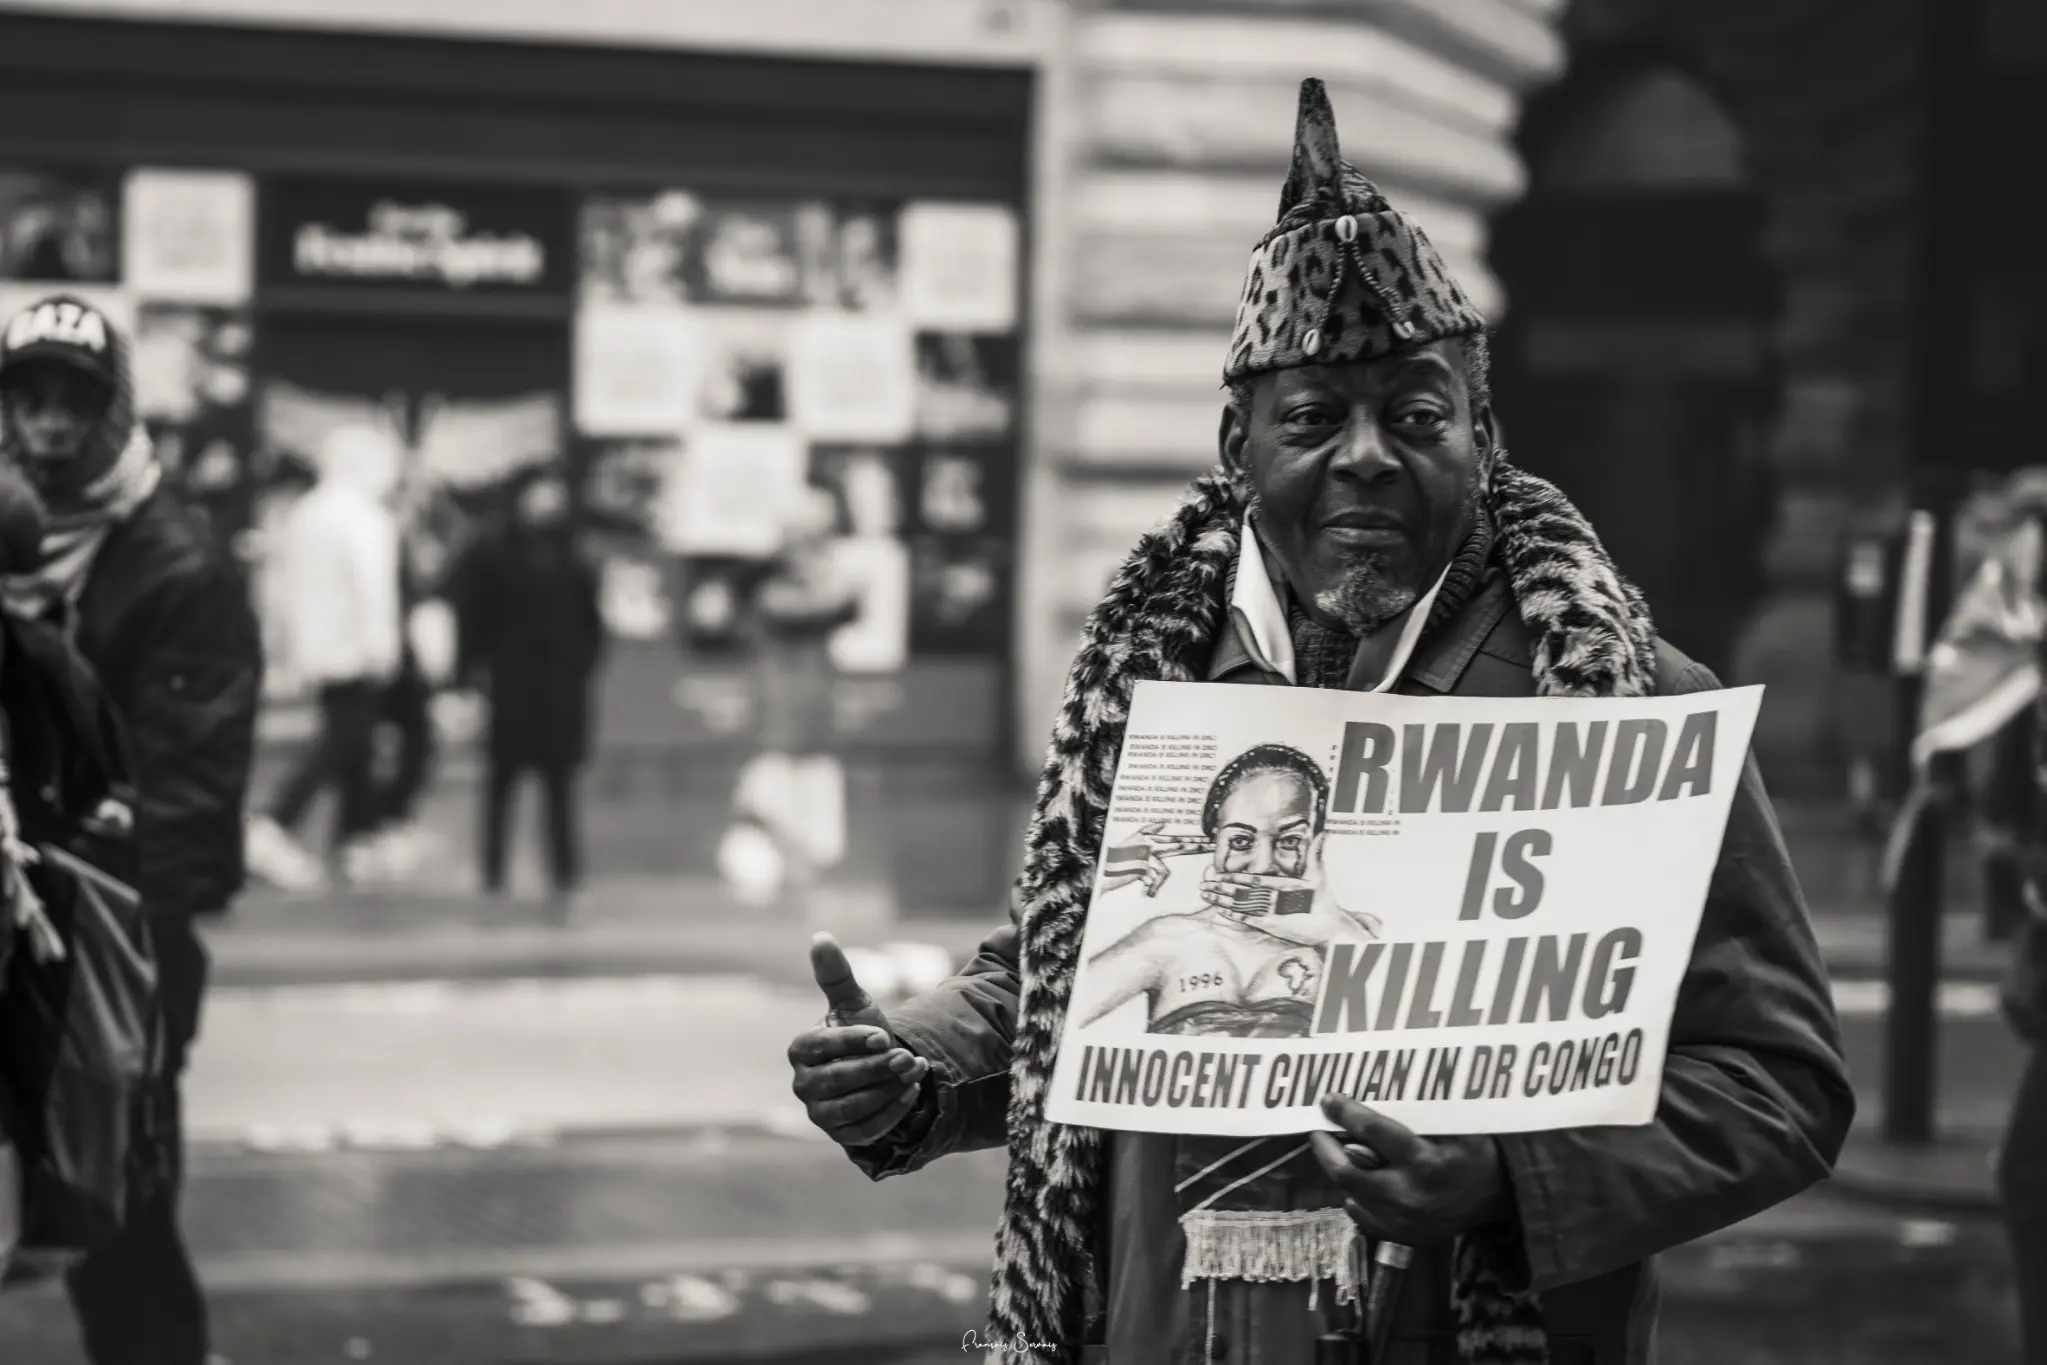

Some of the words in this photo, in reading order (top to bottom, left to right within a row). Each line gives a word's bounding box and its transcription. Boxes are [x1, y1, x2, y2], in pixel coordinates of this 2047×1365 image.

[1332, 710, 1718, 814] RWANDA
[1457, 828, 1552, 921] IS
[1179, 971, 1223, 992] 1996
[1316, 926, 1644, 1033] KILLING
[1076, 1045, 1263, 1109] INNOCENT
[1264, 1049, 1416, 1109] CIVILIAN
[1417, 1046, 1463, 1101] IN
[1463, 1044, 1518, 1101] DR
[1523, 1027, 1643, 1098] CONGO
